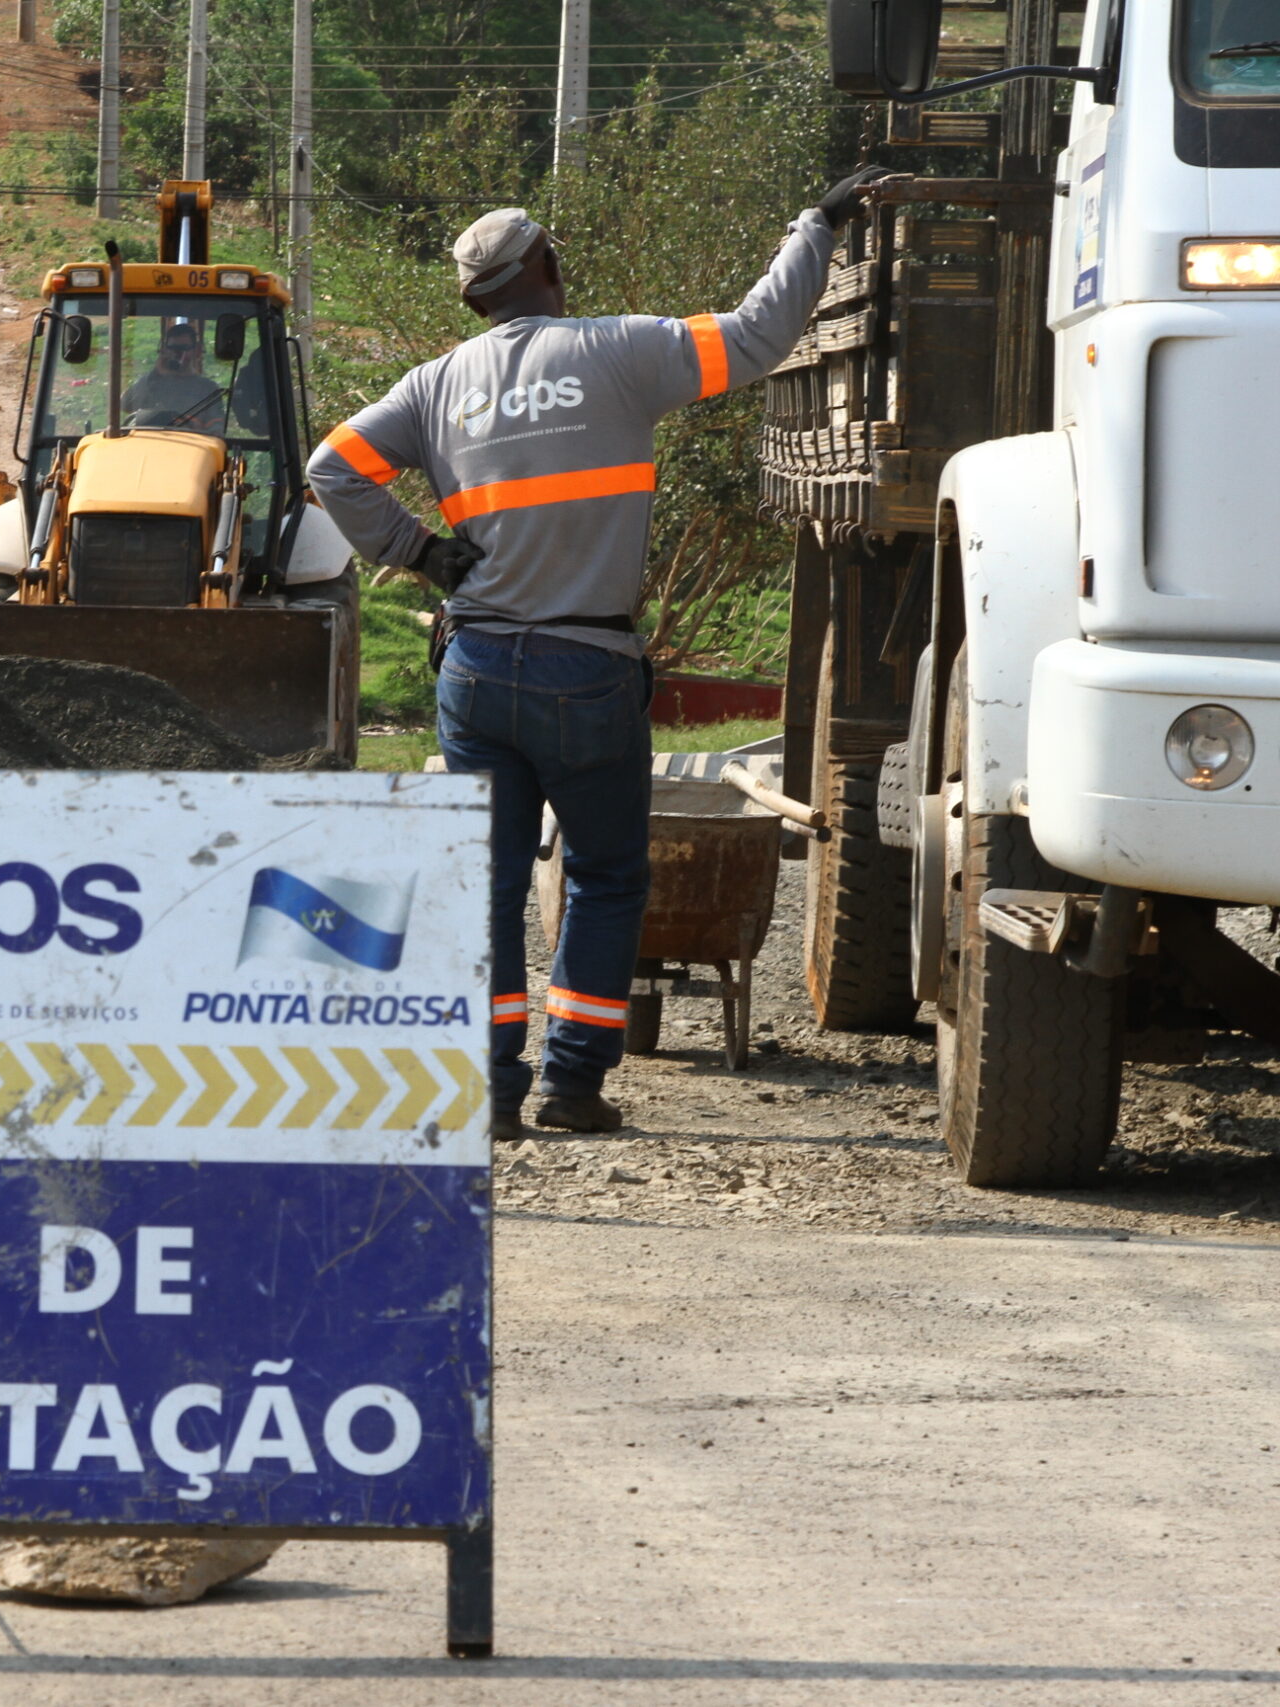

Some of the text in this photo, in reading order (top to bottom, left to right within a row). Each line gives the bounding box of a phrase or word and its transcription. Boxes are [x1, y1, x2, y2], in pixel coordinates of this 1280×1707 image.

[188, 270, 209, 287] 05
[500, 376, 585, 422] cps
[251, 979, 403, 993] CIDADE DE
[10, 1004, 36, 1020] DE
[40, 1005, 140, 1023] SERVIÇOS
[182, 992, 472, 1027] PONTA GROSSA
[38, 1223, 194, 1315] DE
